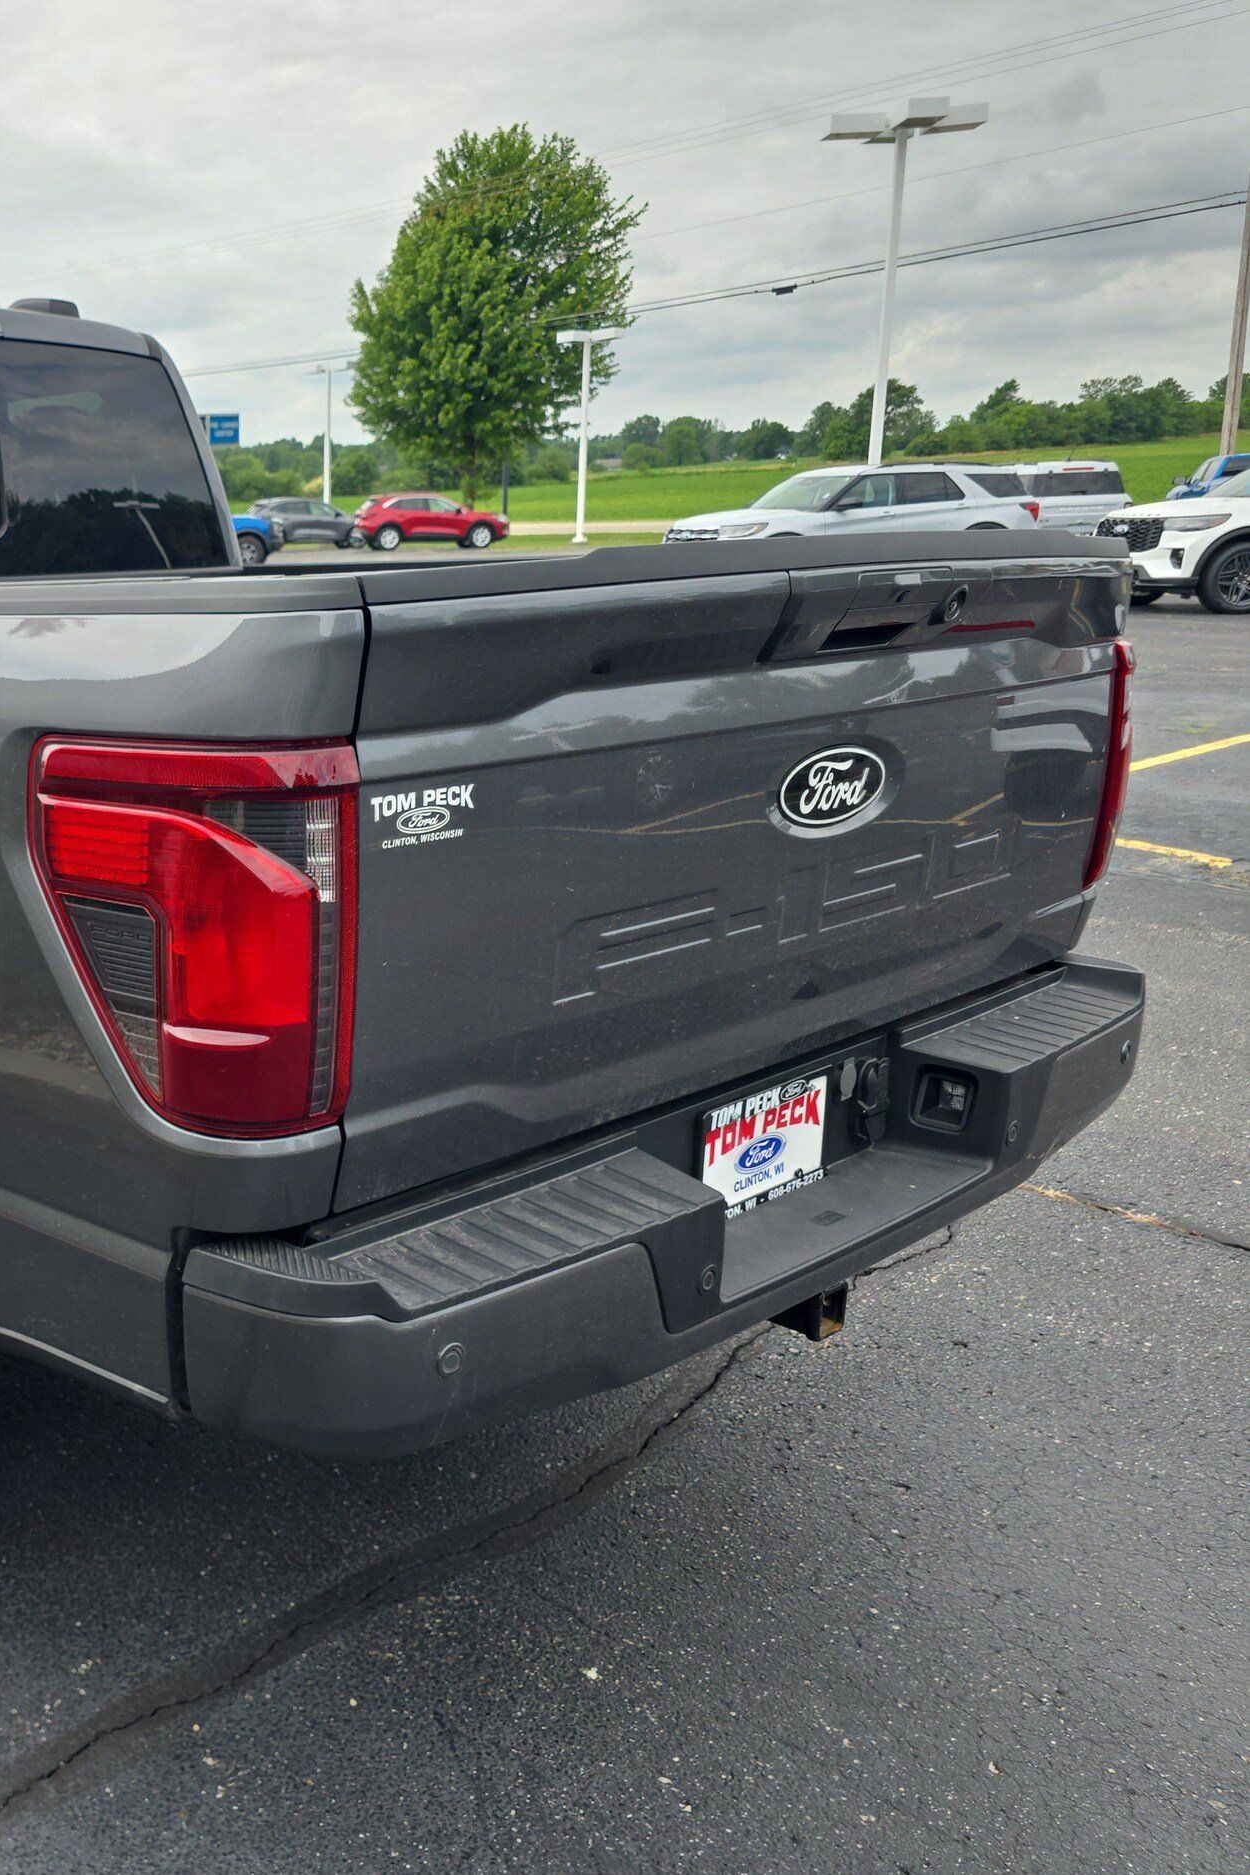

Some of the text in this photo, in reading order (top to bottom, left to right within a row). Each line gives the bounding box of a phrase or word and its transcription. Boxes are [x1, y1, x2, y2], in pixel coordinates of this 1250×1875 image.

[370, 784, 476, 822] TOM PECK
[799, 759, 870, 815] Ford
[382, 828, 464, 849] CLINTON, WISCONSIN
[408, 812, 441, 828] Ford
[551, 818, 1020, 1006] F-150
[90, 925, 152, 944] FORD
[711, 1101, 743, 1130] TOM
[745, 1087, 782, 1117] PECK
[705, 1089, 821, 1167] TOM PECK
[745, 1140, 777, 1167] Ford
[734, 1162, 785, 1192] CLINTON, WI
[745, 1198, 757, 1212] WI
[768, 1169, 824, 1201] 608-676-2273
